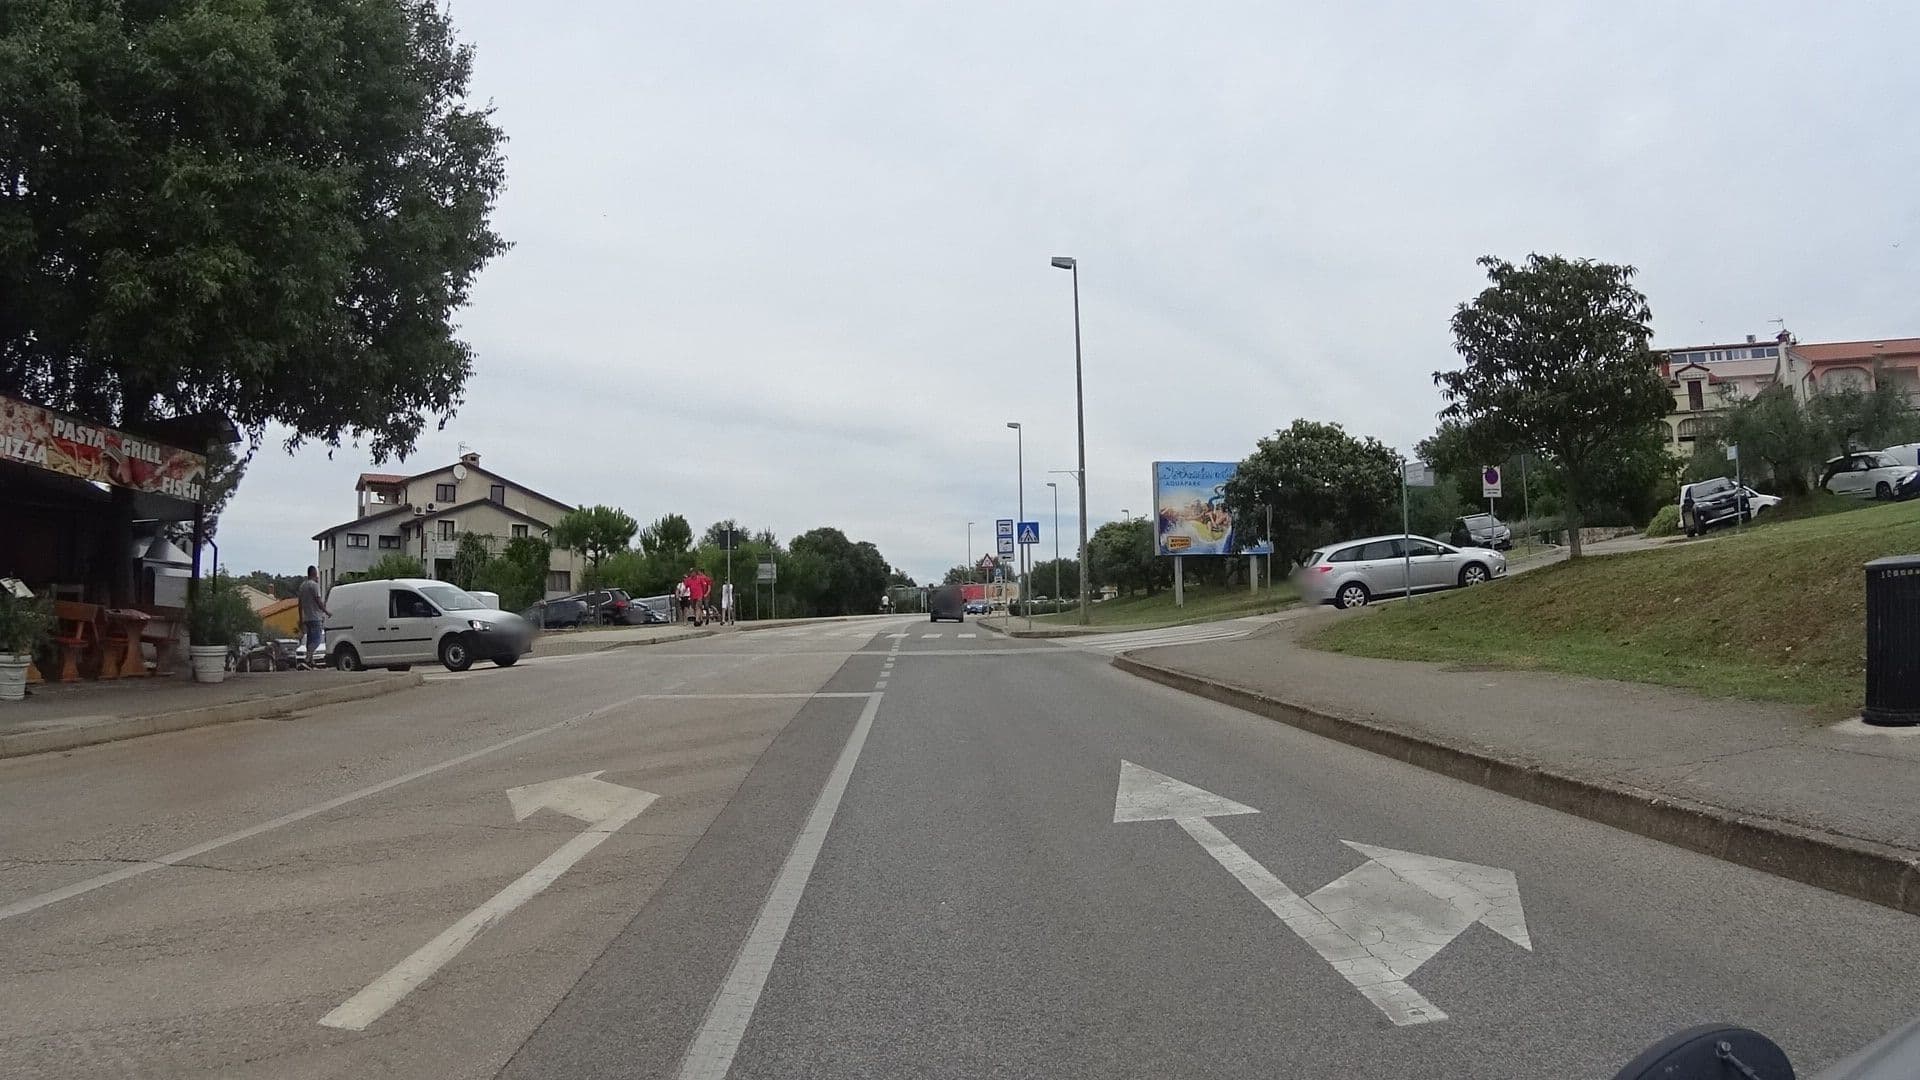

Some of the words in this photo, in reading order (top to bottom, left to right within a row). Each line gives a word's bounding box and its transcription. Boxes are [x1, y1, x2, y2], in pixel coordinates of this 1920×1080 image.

[52, 418, 105, 449] PASTA
[121, 438, 163, 464] GRILL
[161, 476, 201, 500] FISCH
